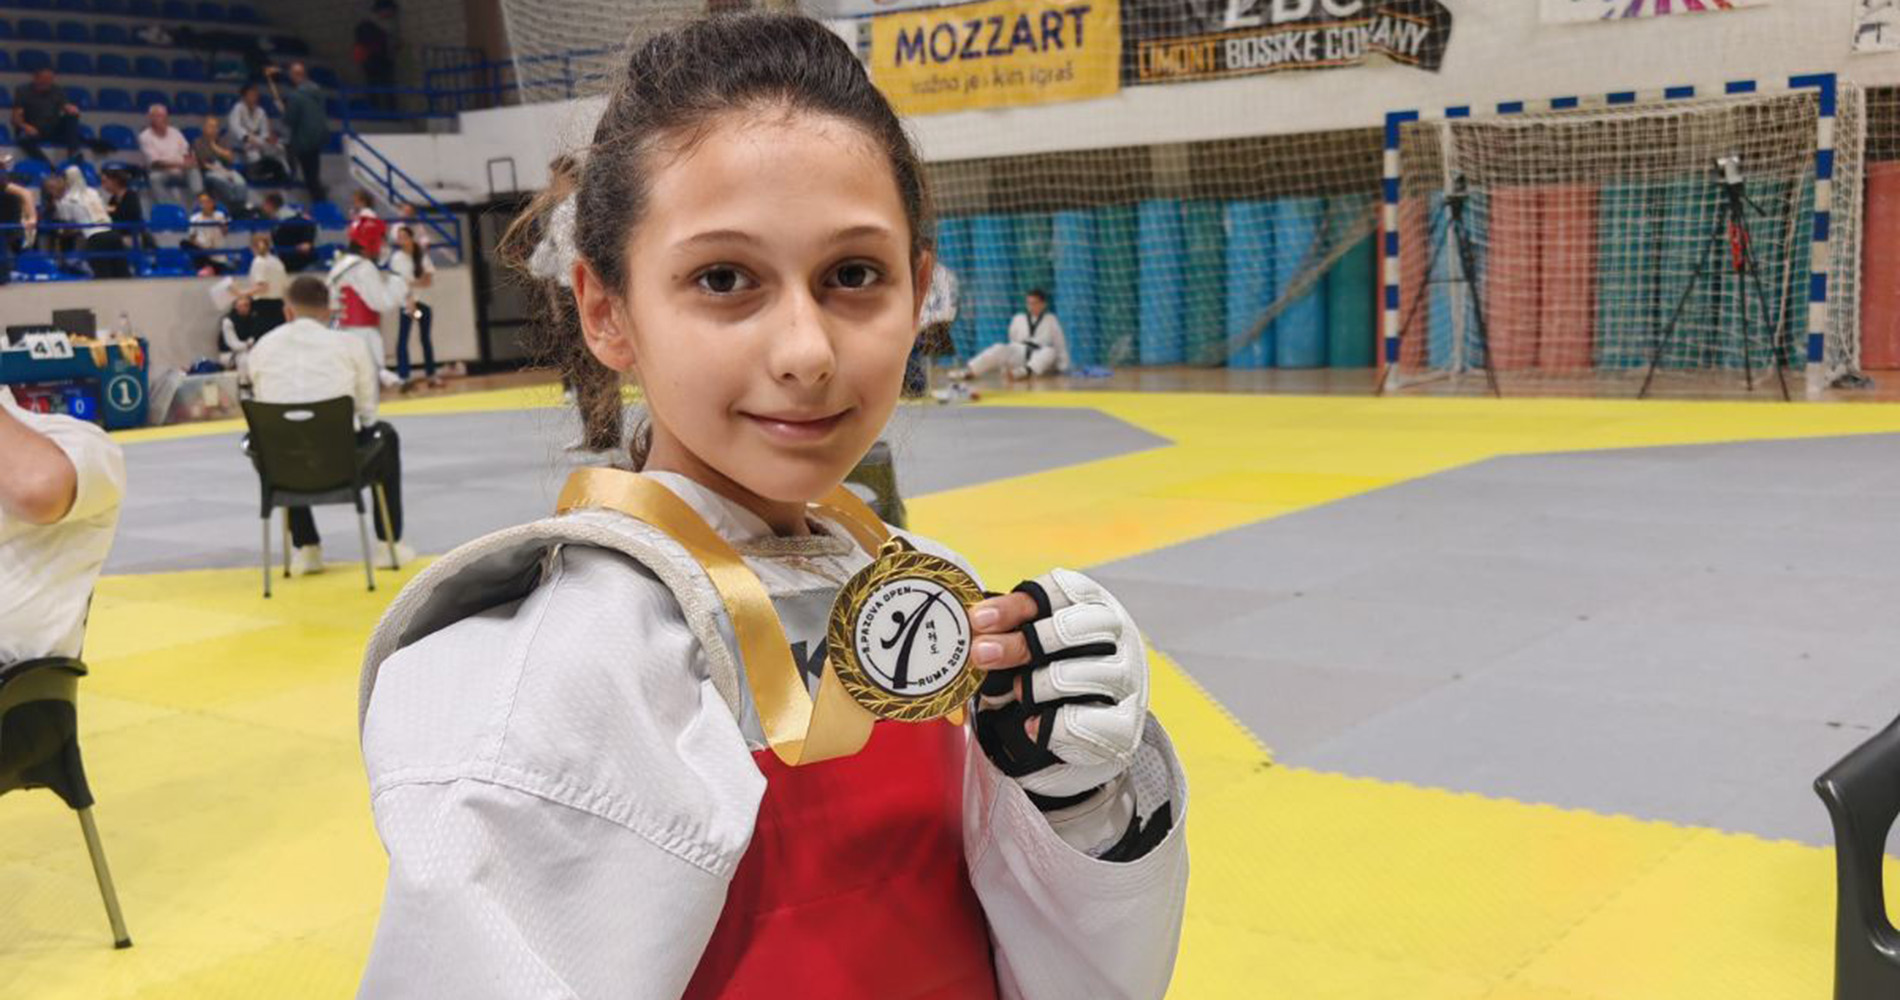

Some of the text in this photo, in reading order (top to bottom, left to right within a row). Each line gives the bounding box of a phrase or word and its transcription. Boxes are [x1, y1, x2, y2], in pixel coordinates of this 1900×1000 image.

[895, 6, 1092, 67] MOZZART
[118, 381, 131, 405] 1
[882, 586, 912, 602] OPEN
[918, 667, 949, 687] RUMA
